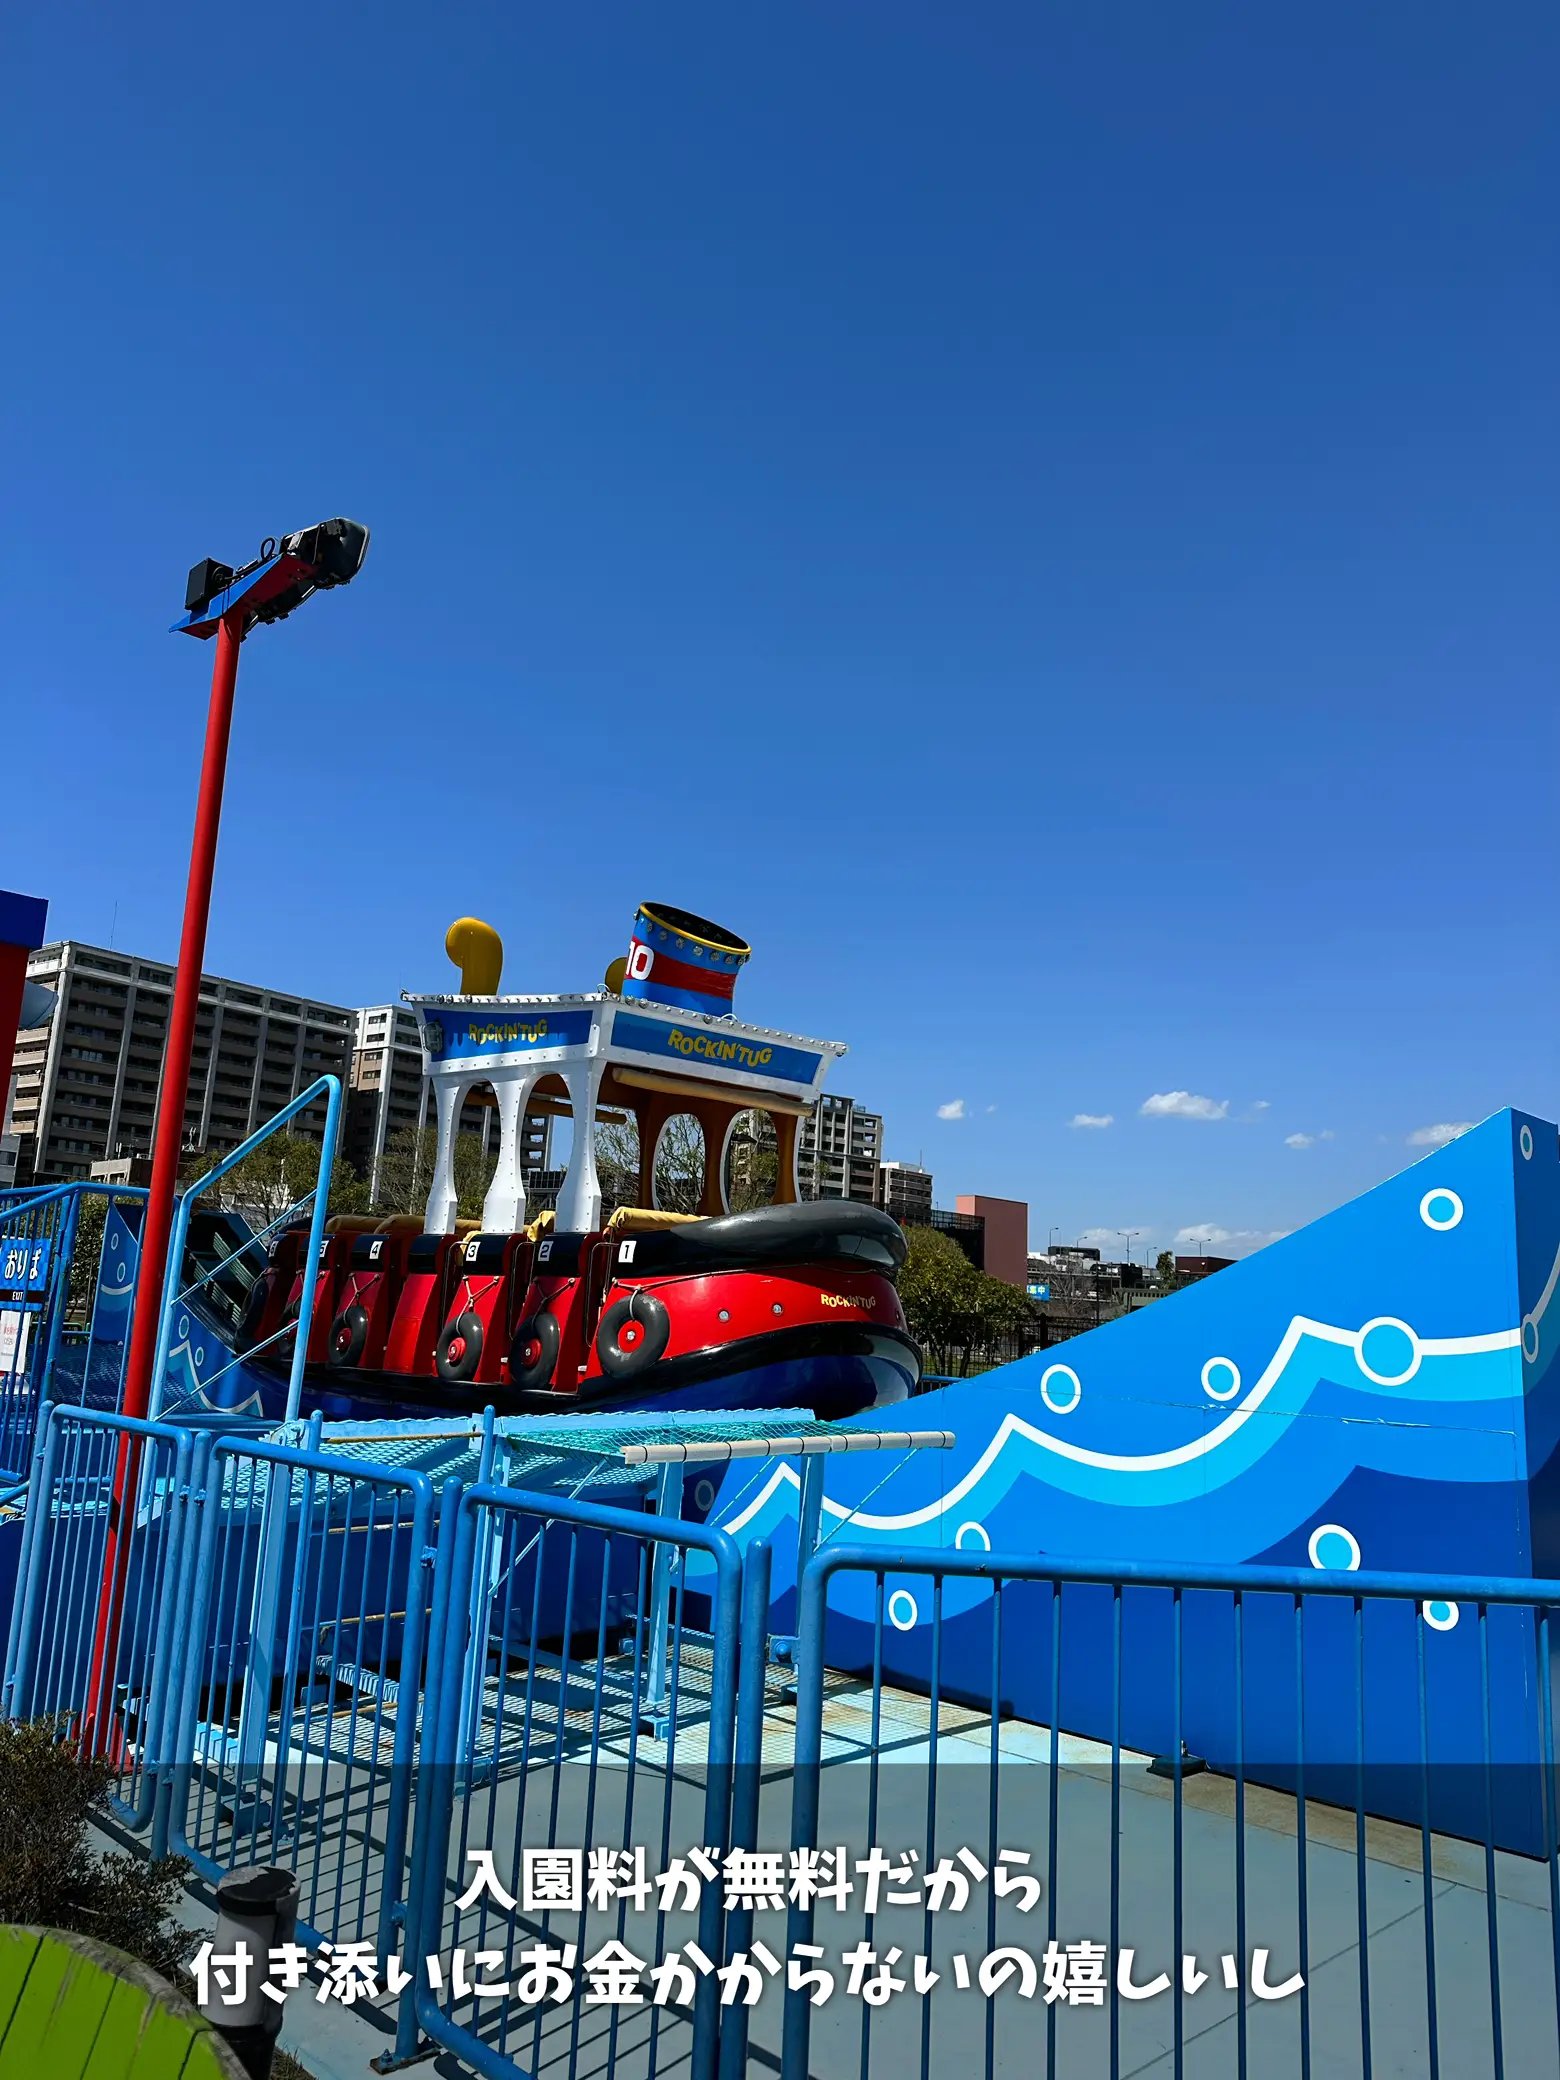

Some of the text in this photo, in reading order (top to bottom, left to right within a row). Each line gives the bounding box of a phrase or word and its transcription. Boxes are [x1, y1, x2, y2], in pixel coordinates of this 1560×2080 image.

[625, 941, 655, 980] 10
[668, 1029, 772, 1067] ROCKIN'TUG
[371, 1244, 379, 1256] 4
[468, 1243, 478, 1258] 3
[540, 1244, 550, 1259] 2
